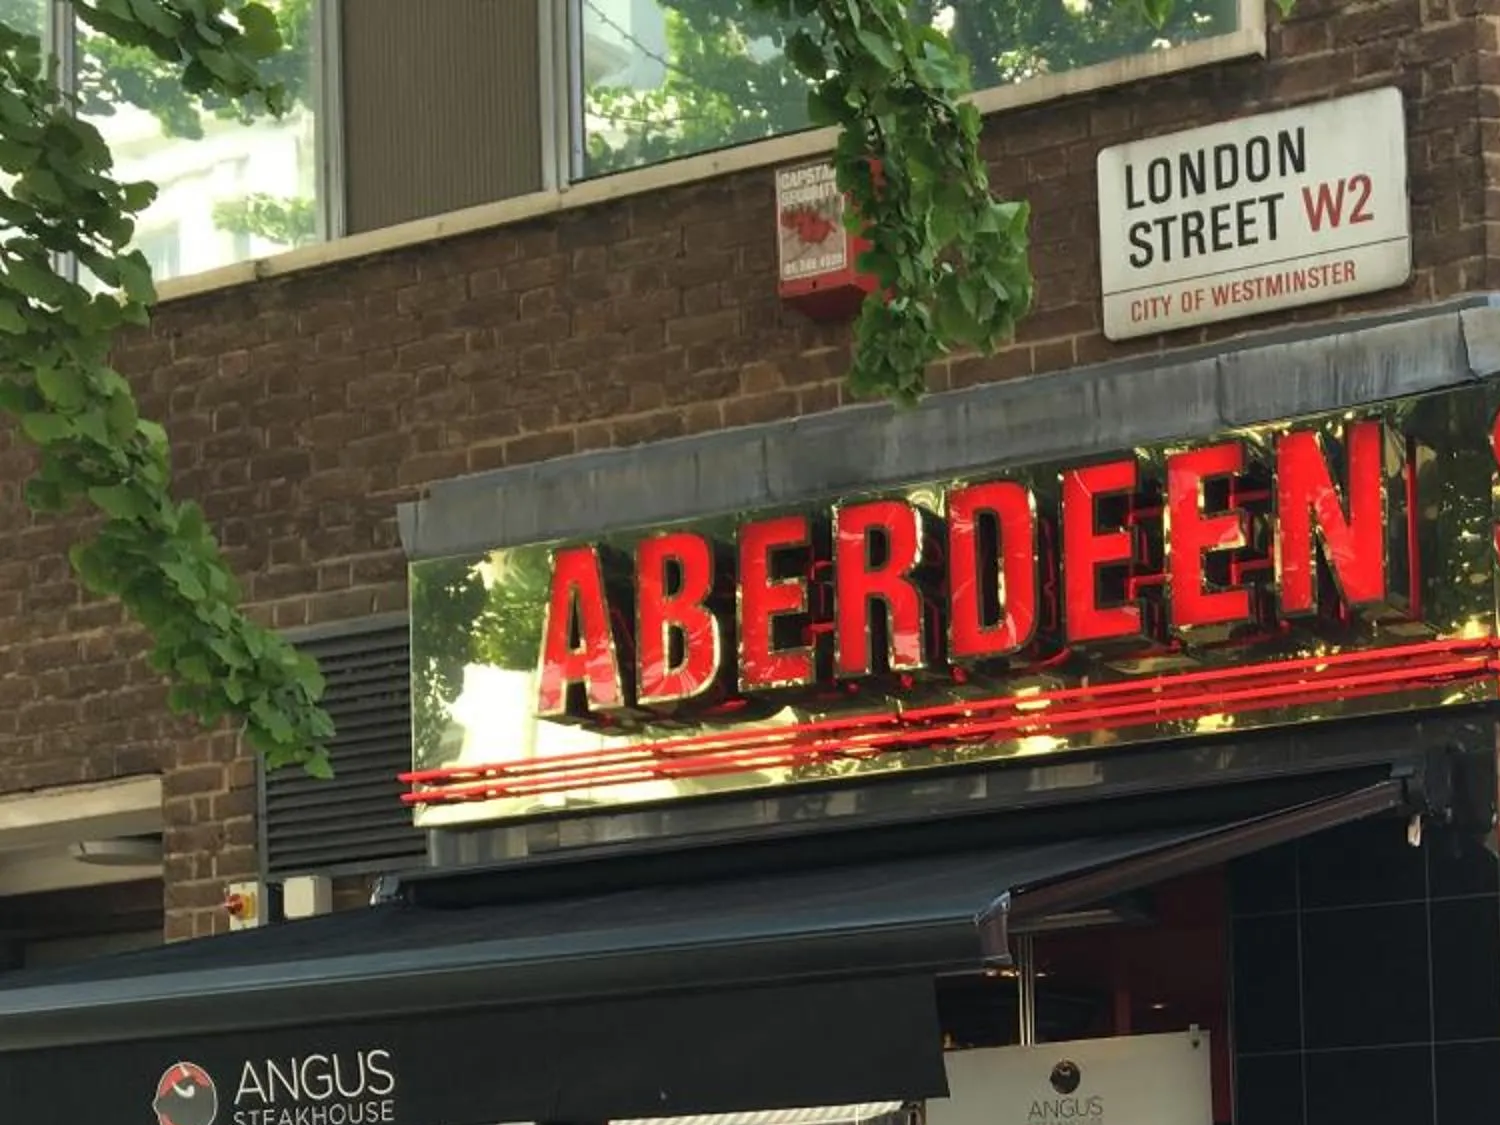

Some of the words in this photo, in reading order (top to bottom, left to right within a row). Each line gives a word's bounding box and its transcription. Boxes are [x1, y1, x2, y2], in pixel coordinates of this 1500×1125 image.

[1125, 127, 1307, 211] LONDON
[1128, 192, 1286, 270] STREET
[1301, 173, 1374, 234] W2
[1130, 299, 1174, 324] CITY
[1180, 292, 1206, 314] OF
[1211, 259, 1357, 309] WESTMINSTER
[536, 416, 1388, 719] ABERDEEN
[233, 1049, 396, 1105] ANGUS
[1027, 1096, 1104, 1121] ANGUS
